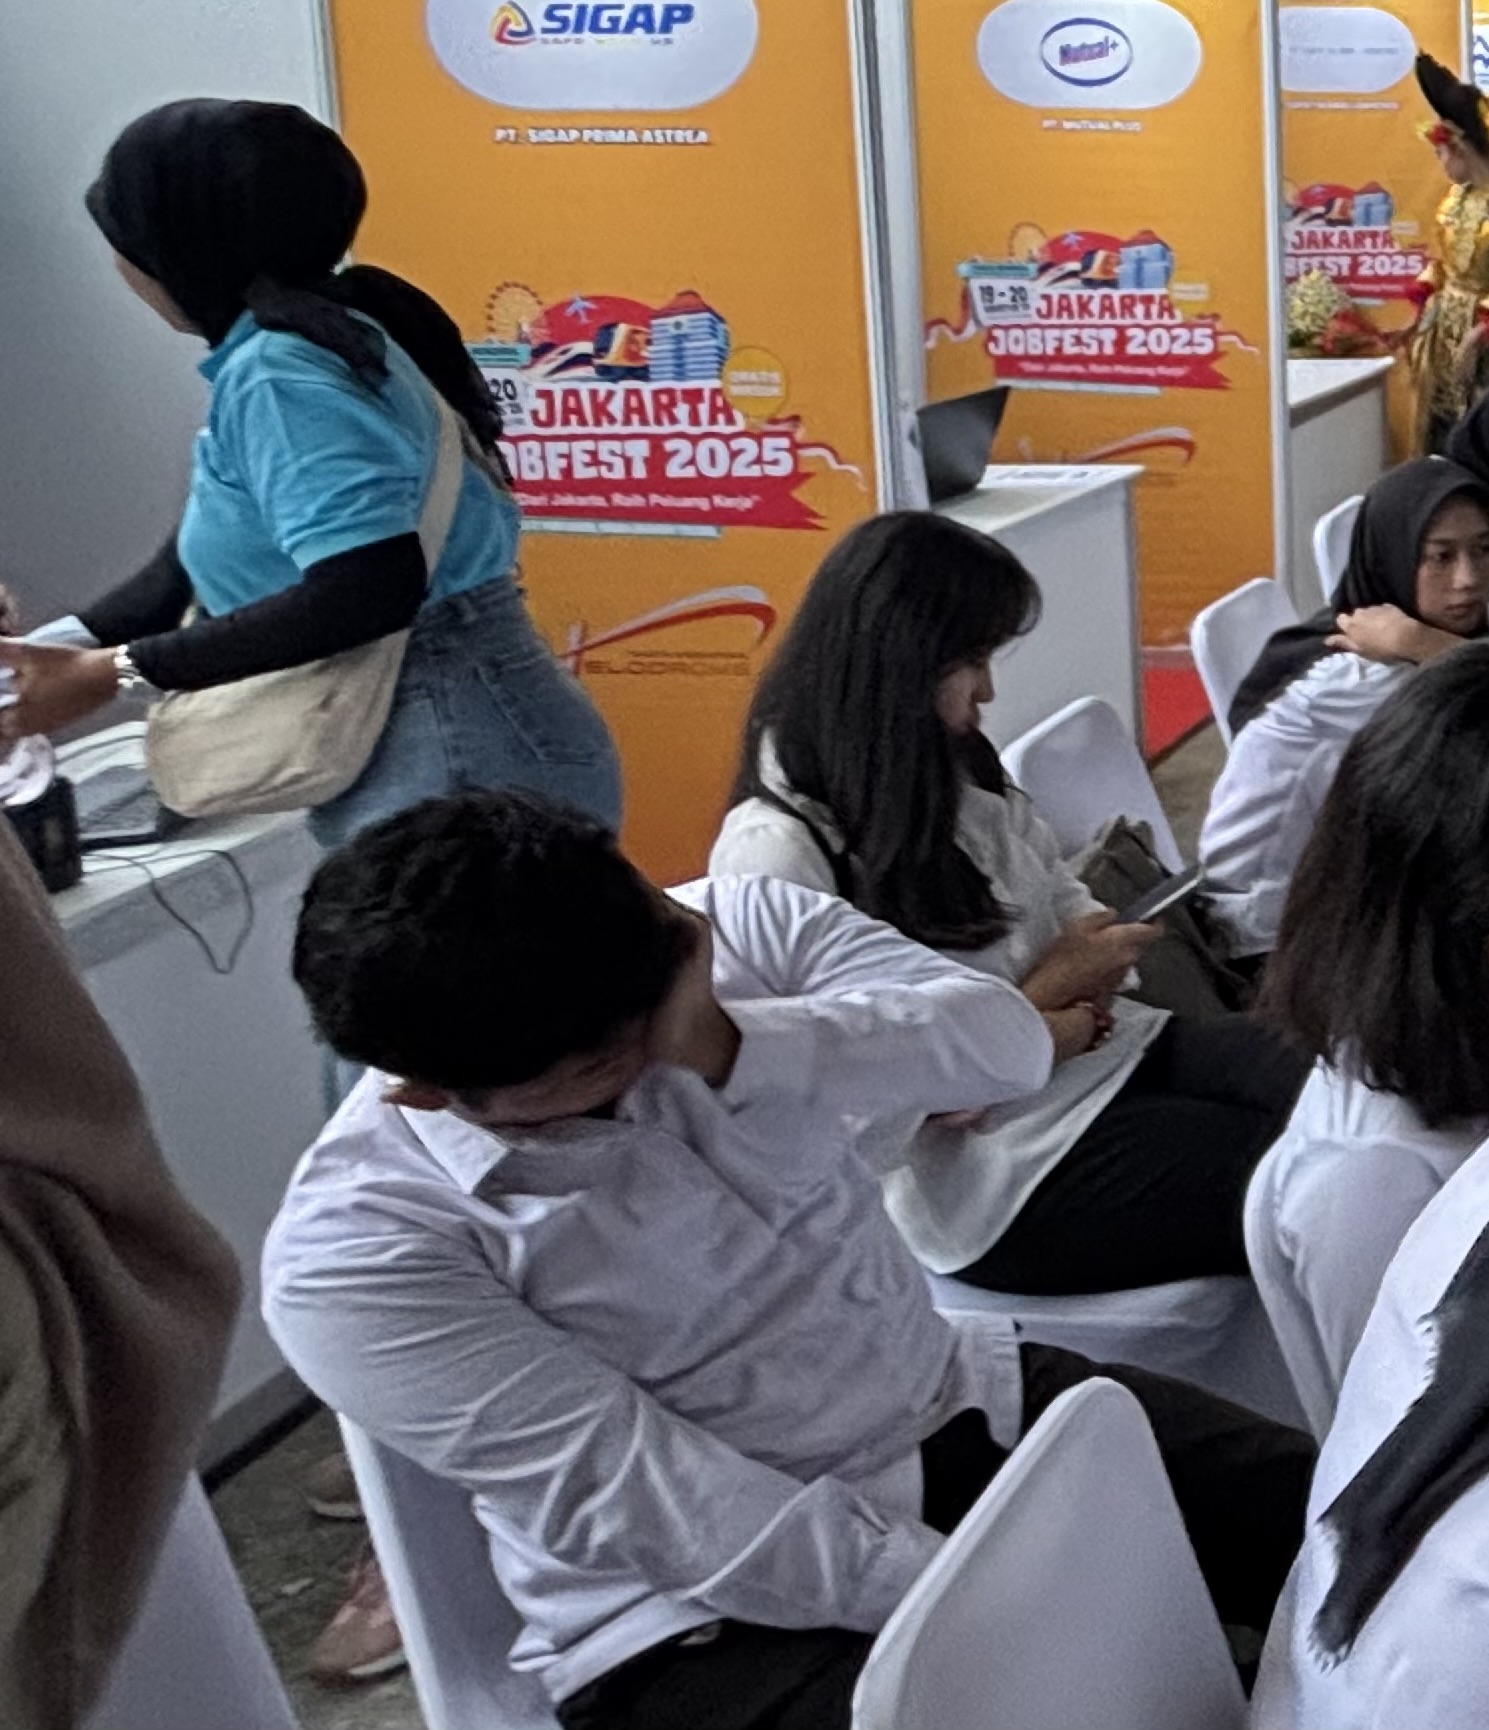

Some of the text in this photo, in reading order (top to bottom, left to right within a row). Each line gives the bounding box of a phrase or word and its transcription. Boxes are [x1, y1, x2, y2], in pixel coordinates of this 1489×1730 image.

[541, 3, 695, 35] SIGAP
[527, 129, 579, 143] SIGAP
[1292, 229, 1397, 249] JAKARTA
[1357, 255, 1423, 275] 2025
[1036, 292, 1177, 321] JAKARTA
[988, 327, 1215, 356] JOBFEST 2025
[532, 387, 736, 427] JAKARTA
[663, 437, 793, 478] 2025
